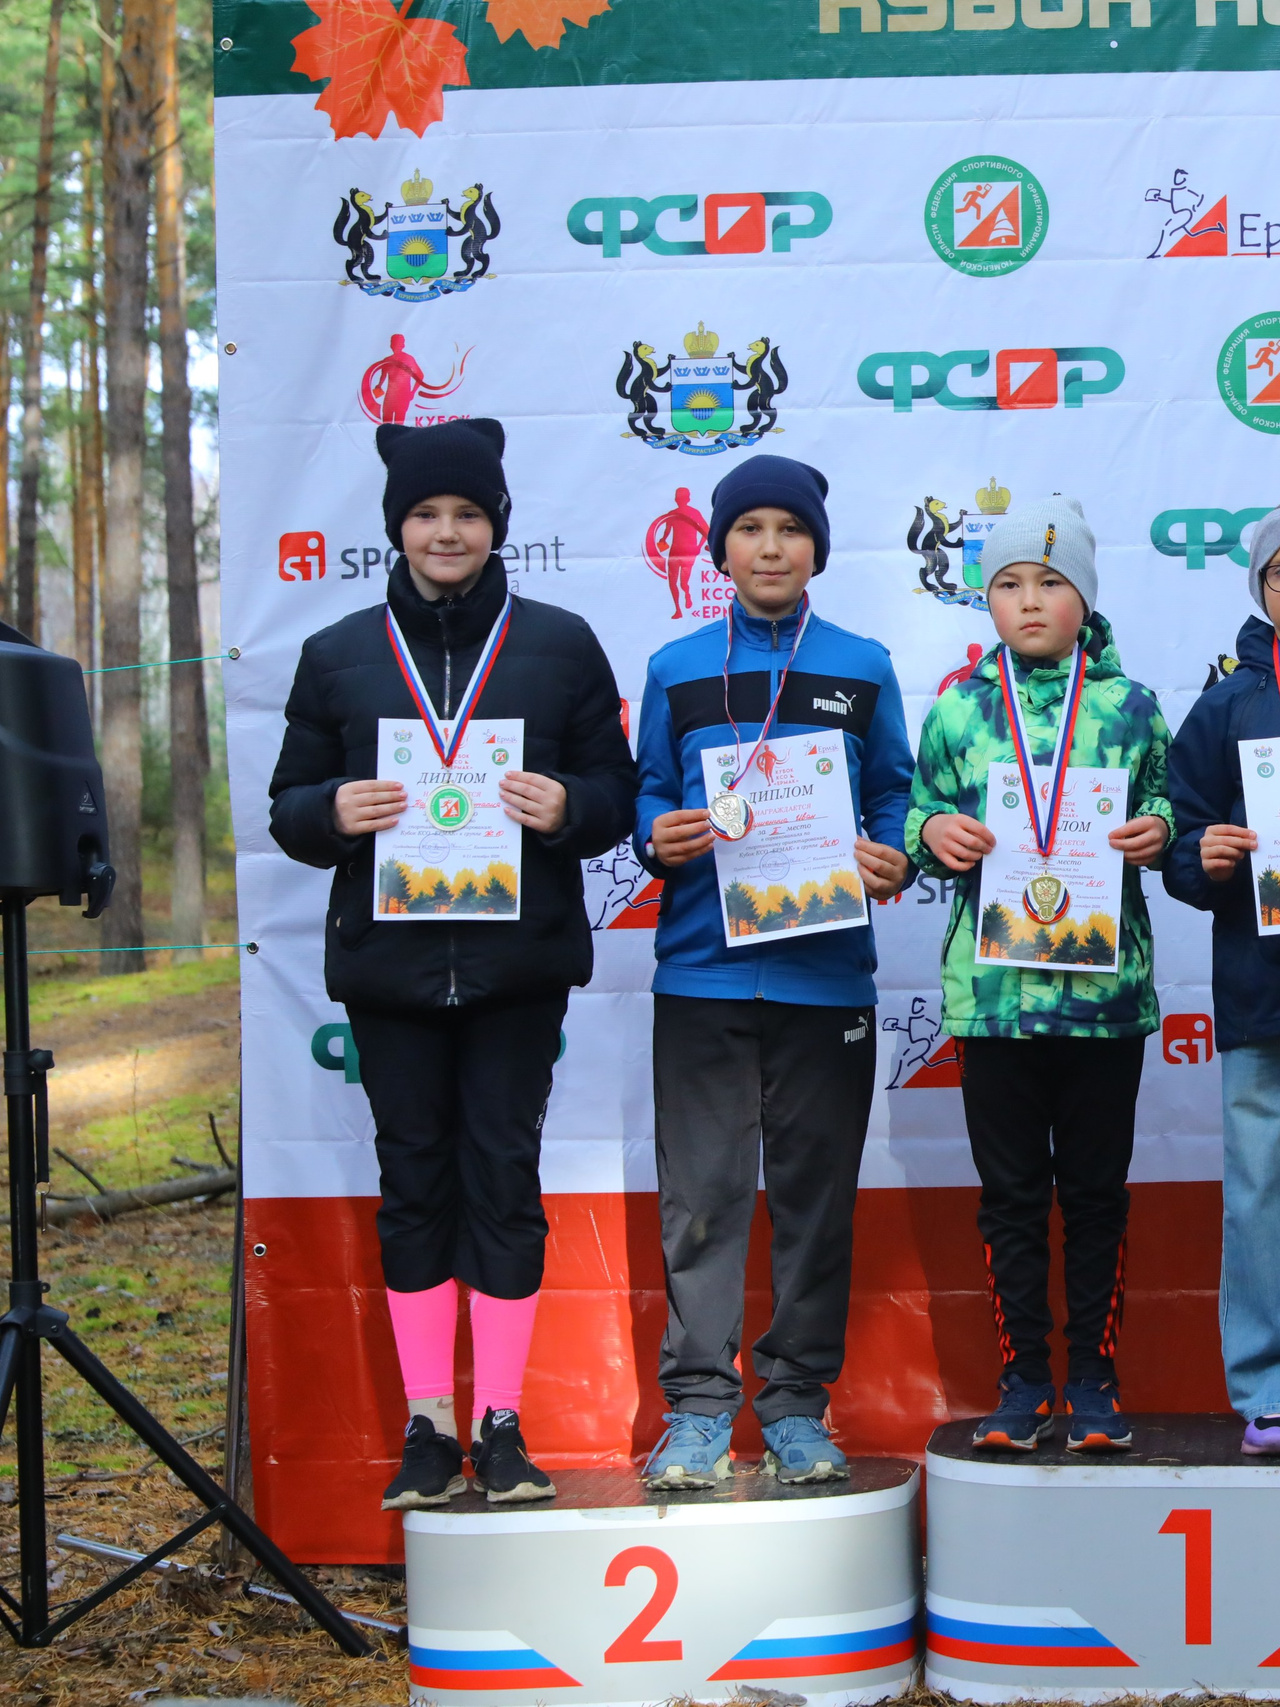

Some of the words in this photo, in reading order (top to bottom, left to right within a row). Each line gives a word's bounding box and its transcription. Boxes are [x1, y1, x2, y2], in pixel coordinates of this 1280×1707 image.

[962, 161, 1023, 179] СПОРТИВНОГО
[930, 172, 958, 218] ФЕДЕРАЦИЯ
[1020, 183, 1044, 258] ОРИЕНТИРОВАНИЯ
[931, 223, 955, 259] ОБЛАСТИ
[960, 259, 1014, 272] ТЮМЕНСКОЙ
[1222, 328, 1250, 375] ФЕДЕРАЦИЯ
[1223, 380, 1248, 416] ОБЛАСТИ
[813, 698, 848, 716] PUMA
[749, 784, 814, 803] ДИПЛОМ
[754, 803, 812, 816] НАГРАЖДАЕТСЯ
[786, 824, 811, 832] место
[1023, 818, 1091, 833] ДЛОМ
[844, 1026, 866, 1043] PUMA
[1158, 1509, 1212, 1646] 1
[604, 1545, 683, 1664] 2
